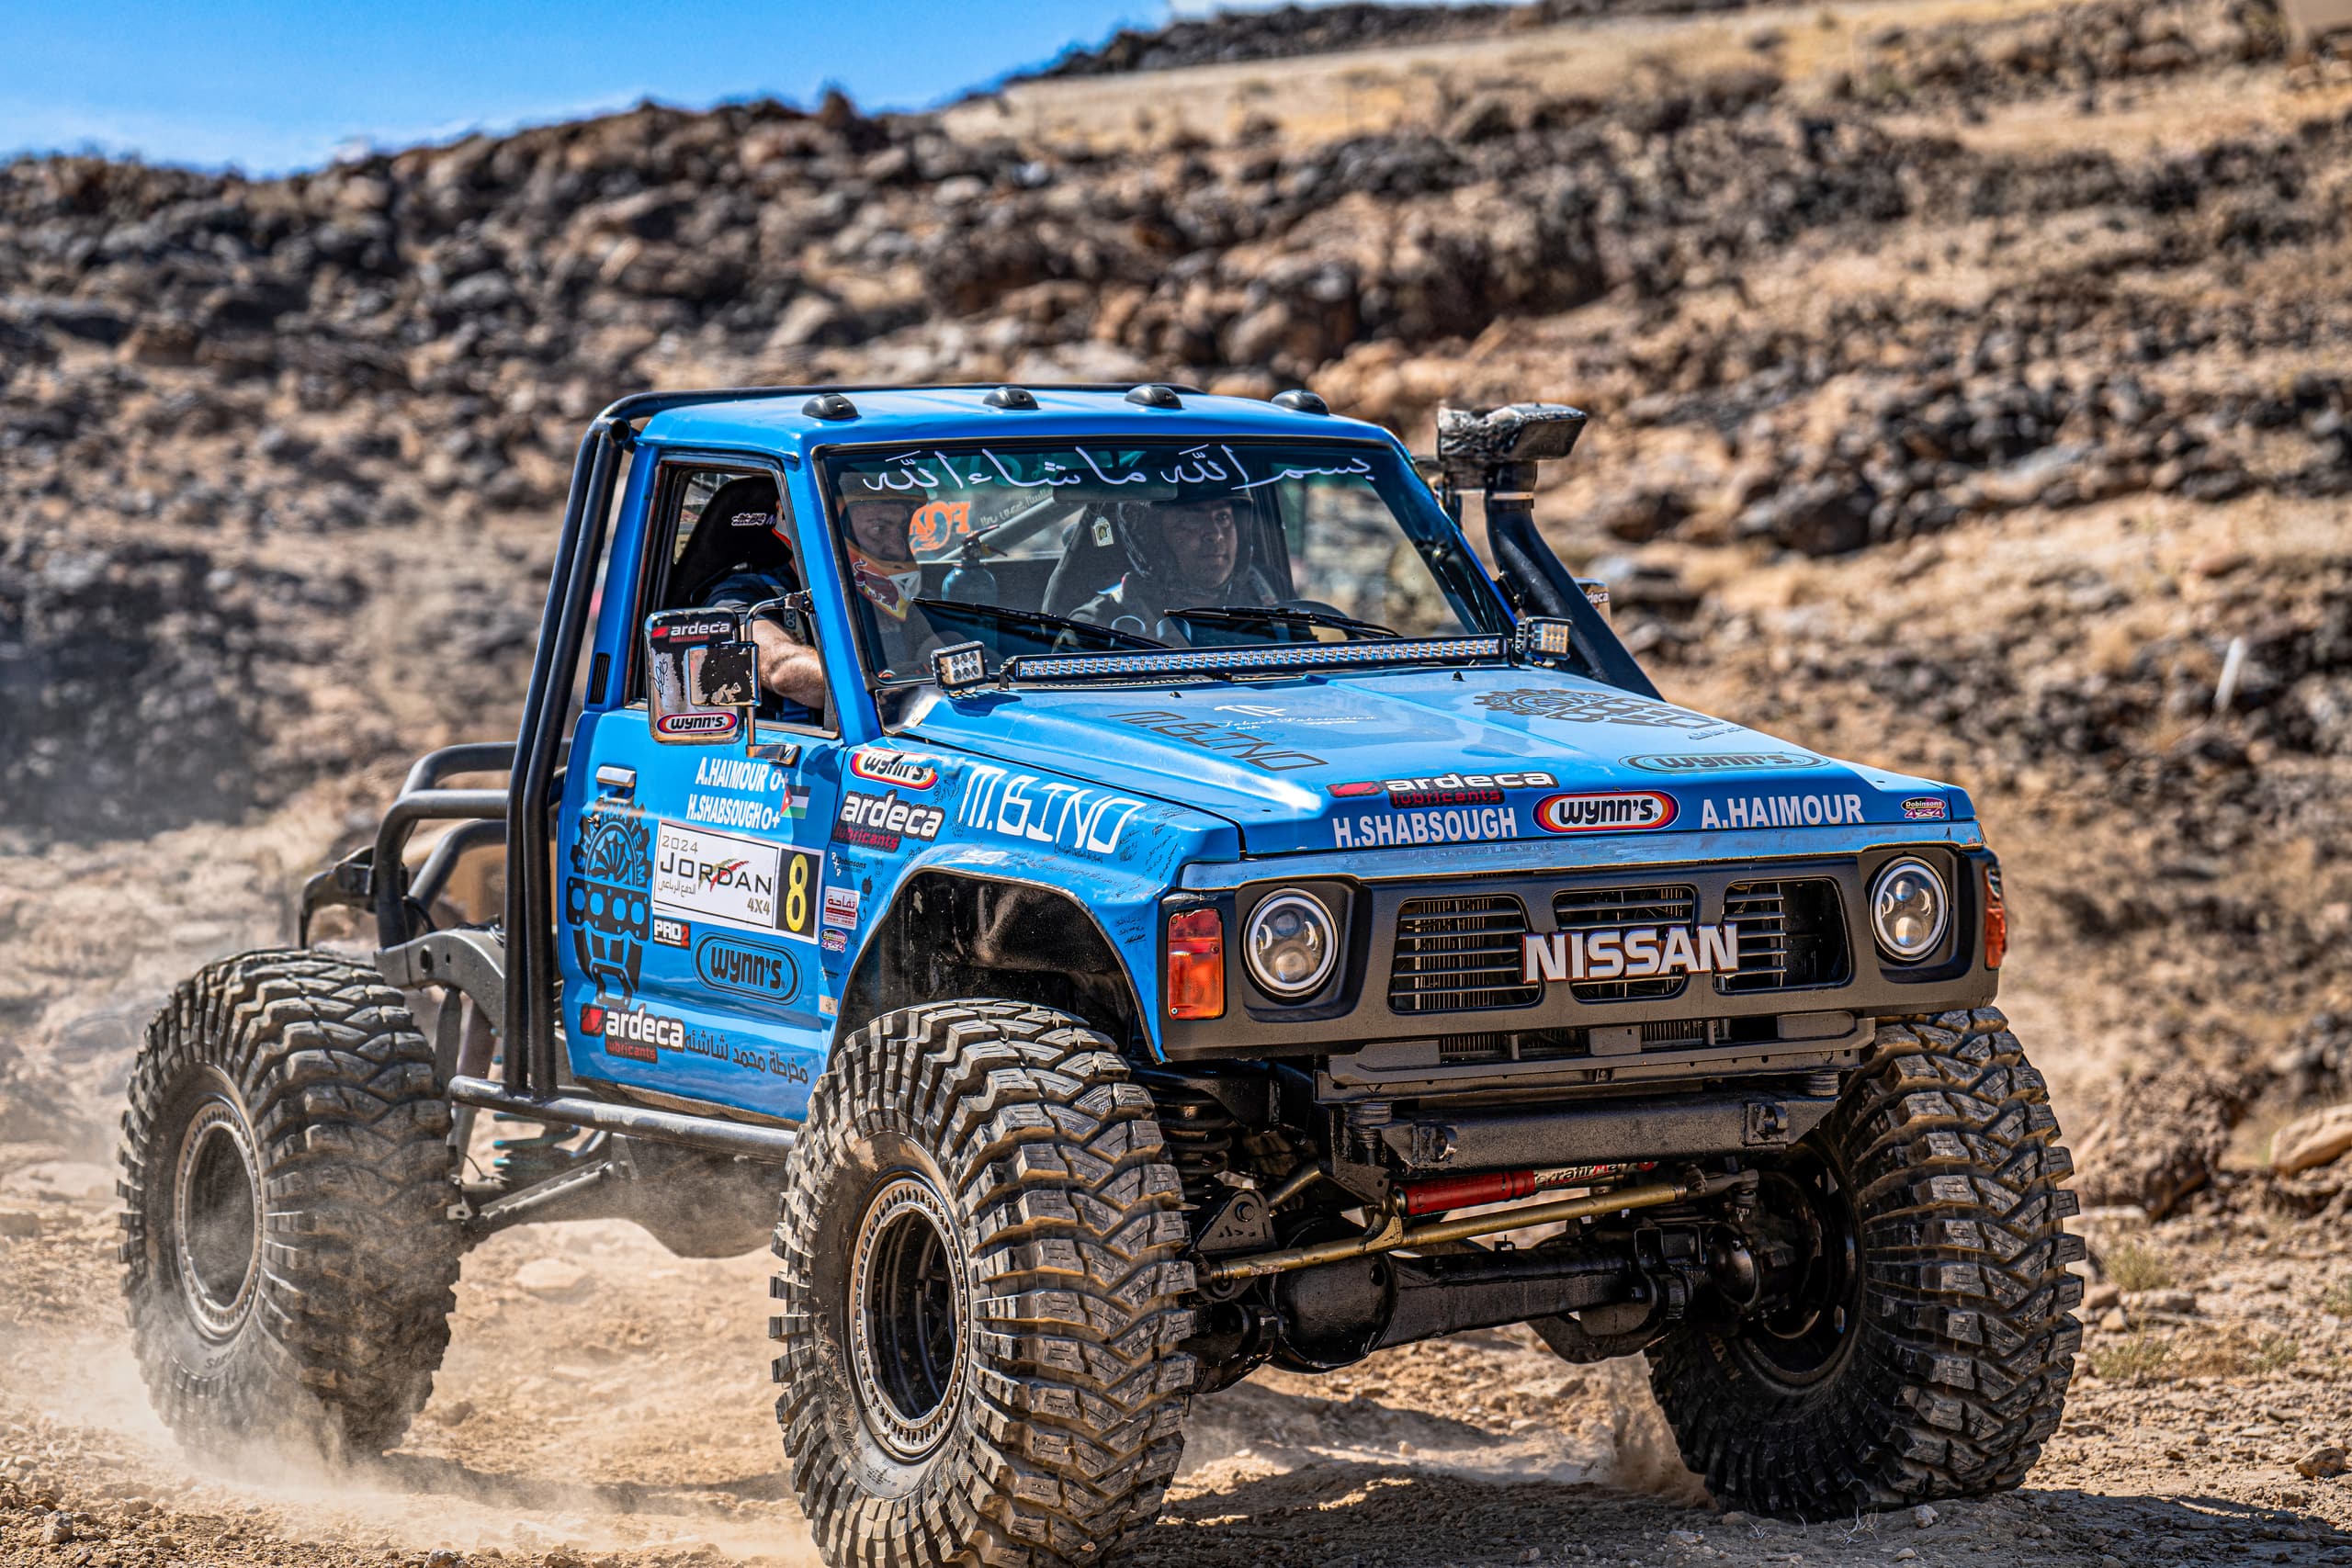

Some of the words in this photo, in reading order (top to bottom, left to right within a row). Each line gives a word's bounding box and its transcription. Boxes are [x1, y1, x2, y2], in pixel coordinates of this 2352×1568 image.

[671, 622, 730, 637] ardeca
[695, 756, 770, 793] A.HAIMOUR
[1386, 772, 1554, 792] ardeca
[685, 793, 763, 829] H.SHABSOUGH
[842, 790, 944, 839] ardeca
[1393, 789, 1501, 805] lubricants
[1701, 793, 1865, 830] A.HAIMOUR
[661, 835, 699, 854] 2024
[833, 823, 900, 850] lubricants
[1332, 807, 1519, 849] H.SHABSOUGH
[660, 852, 772, 896] JORDAN
[786, 853, 808, 932] 8
[1522, 921, 1740, 985] NISSAN
[605, 1004, 684, 1047] ardeca
[605, 1038, 656, 1060] lubricants
[732, 1046, 766, 1073] محمد
